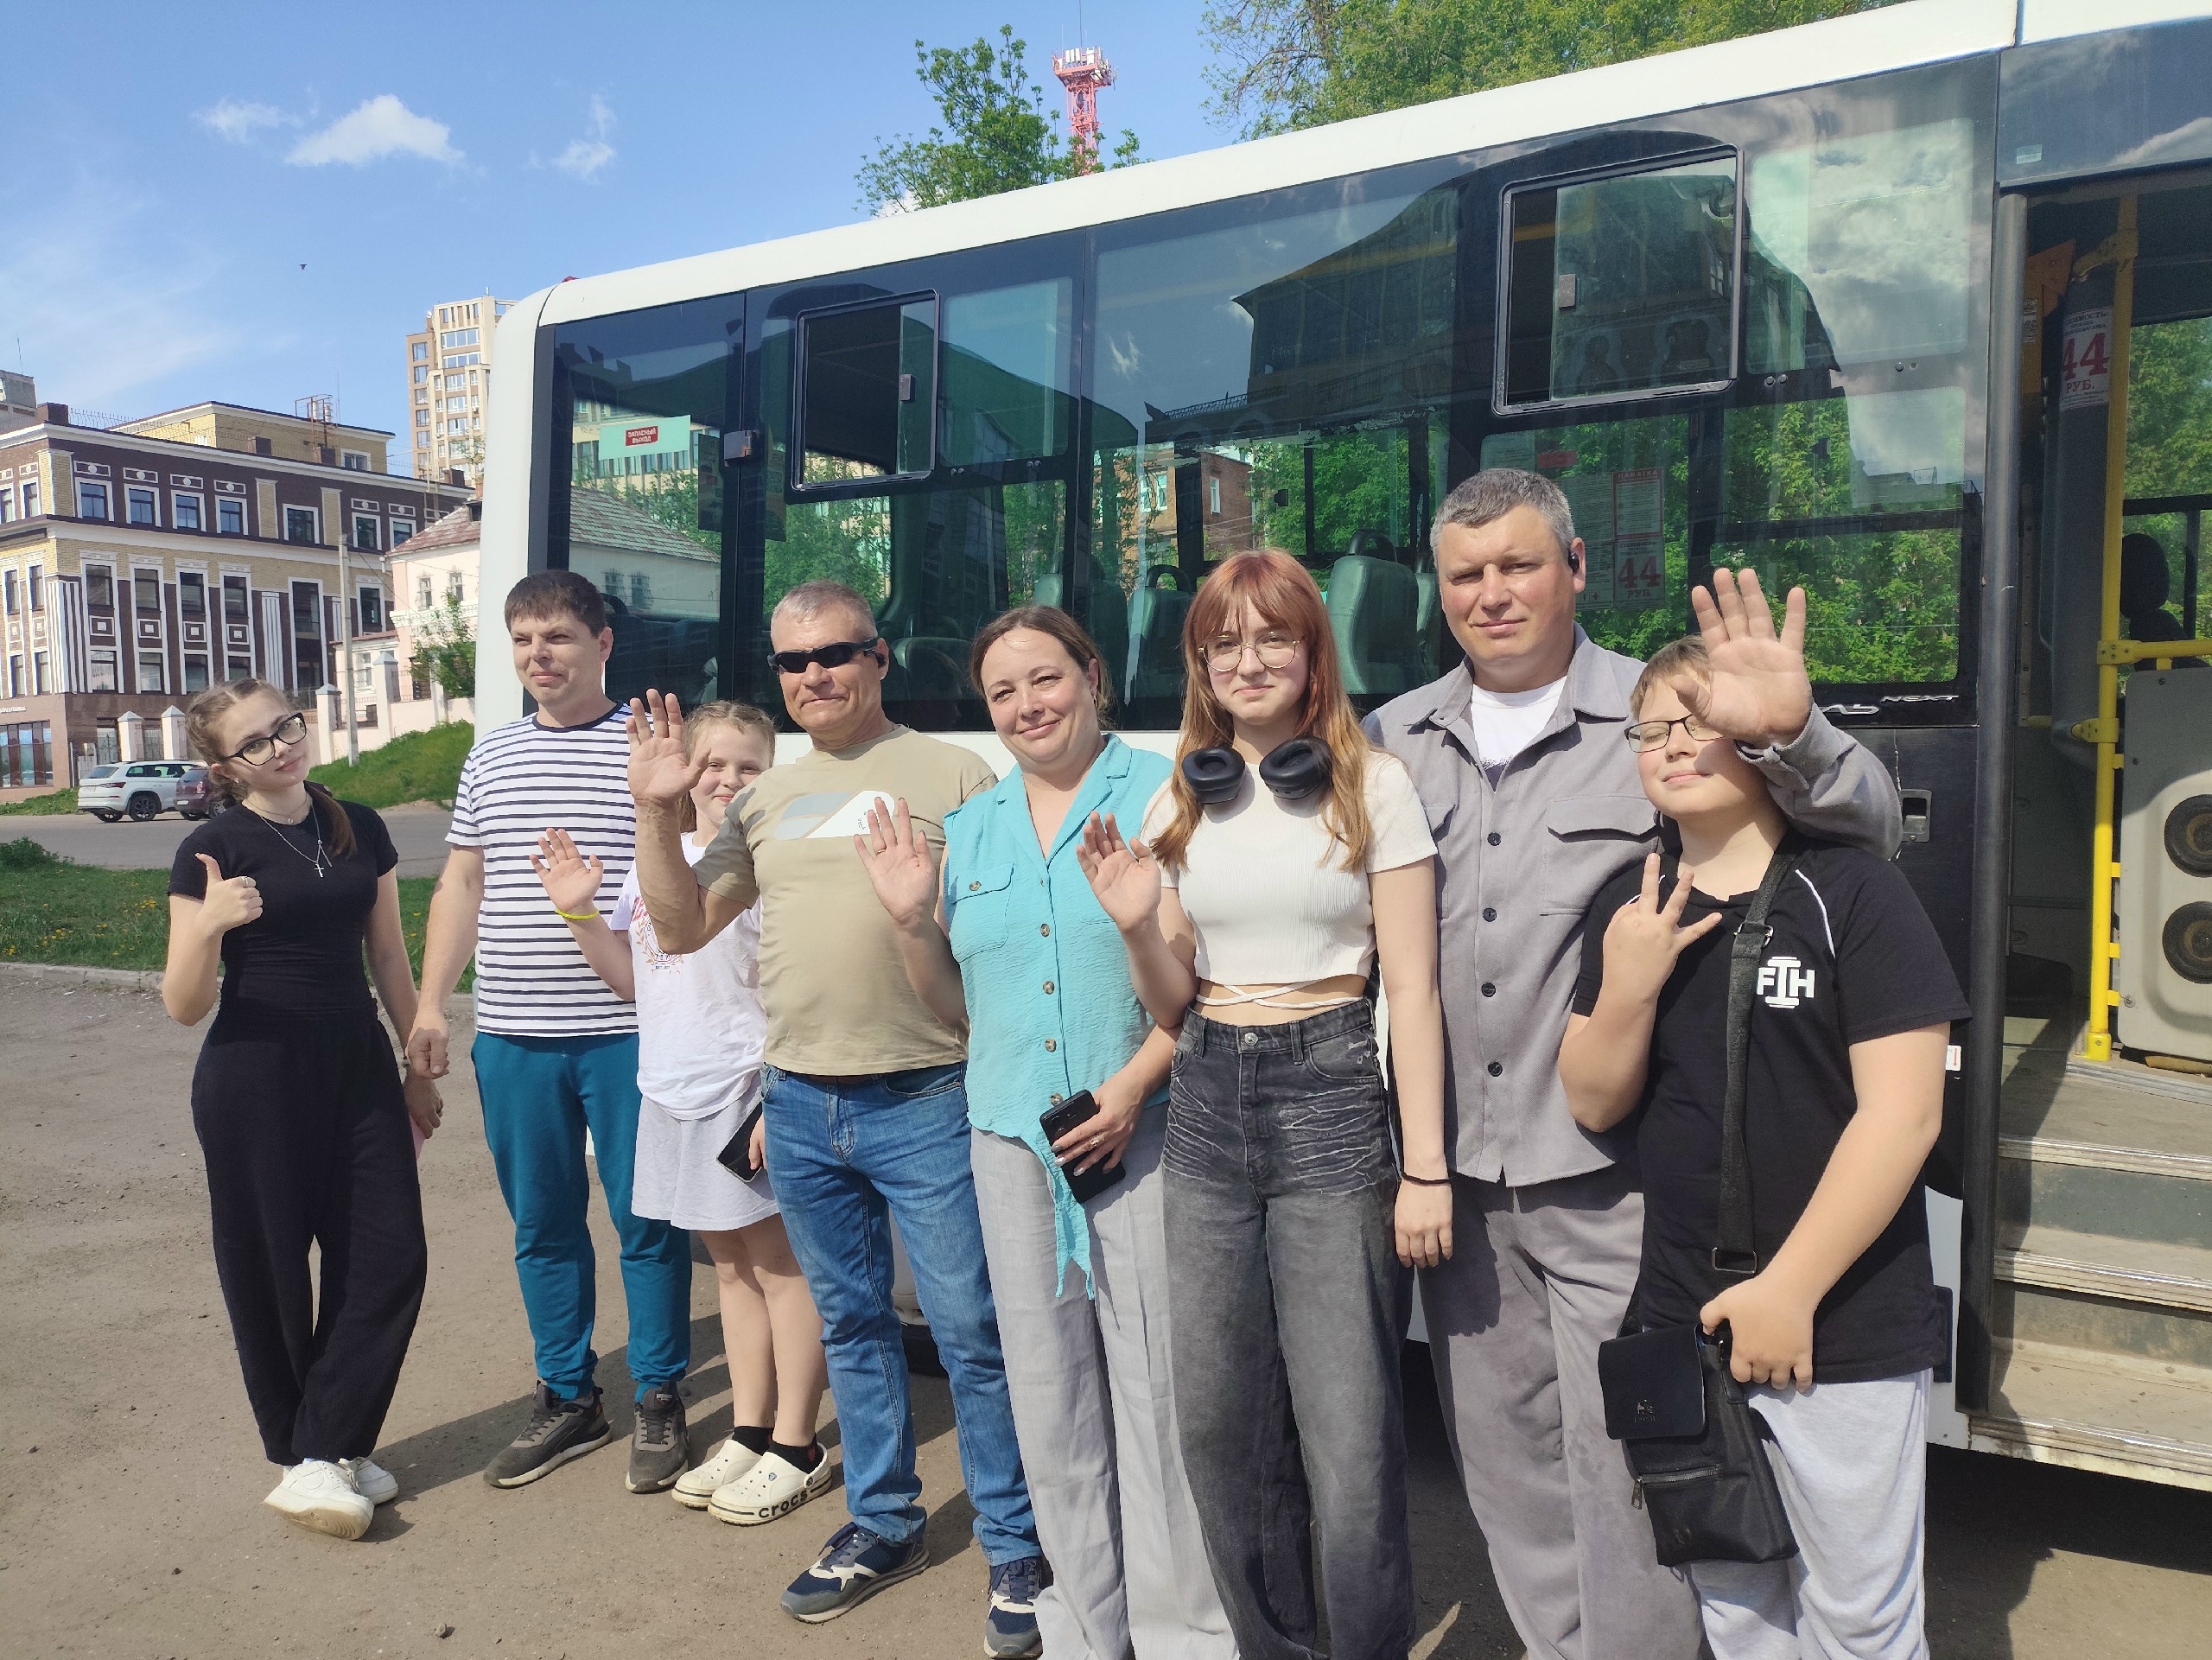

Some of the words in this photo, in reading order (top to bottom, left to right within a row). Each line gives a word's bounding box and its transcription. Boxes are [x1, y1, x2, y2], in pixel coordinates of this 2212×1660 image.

[2063, 333, 2110, 381] 44
[627, 428, 657, 438] ЗАПАСНЫЙ
[632, 436, 652, 444] ВЫХОД
[1618, 556, 1661, 588] 44
[758, 1489, 808, 1518] crocs
